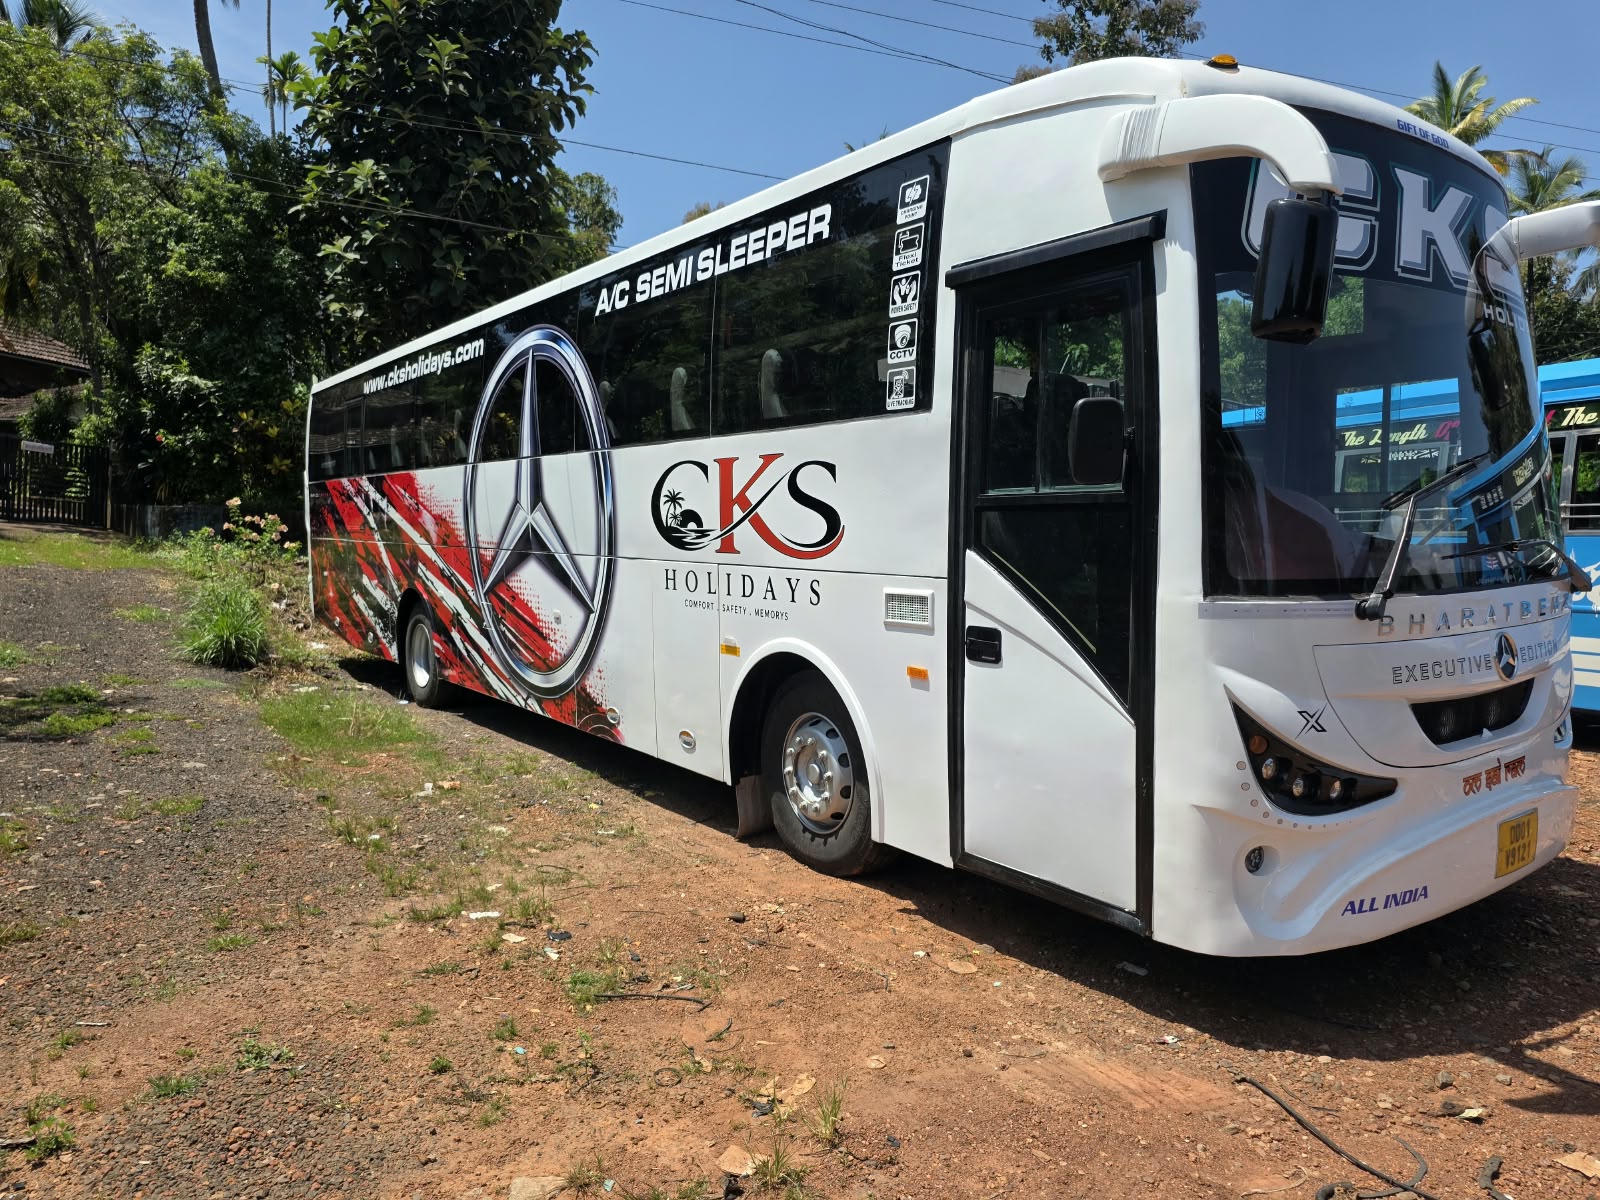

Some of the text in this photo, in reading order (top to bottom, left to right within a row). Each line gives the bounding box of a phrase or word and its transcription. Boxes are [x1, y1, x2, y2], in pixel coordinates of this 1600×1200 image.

[1397, 119, 1449, 149] GIFT OF GOD
[595, 203, 833, 317] A/C SEMI SLEEPER
[895, 257, 919, 268] Ticket
[363, 338, 484, 395] www.cksholidays.com
[889, 348, 915, 360] CCTV
[1560, 406, 1599, 427] The
[1341, 430, 1366, 447] The
[1368, 423, 1429, 446] Lngth
[651, 453, 846, 560] CKS
[664, 568, 822, 607] HOLIDAYS
[684, 599, 789, 621] COMFORT SAFETY MEMORYS
[1392, 640, 1558, 685] EXECUTIVE EDITION
[1341, 885, 1429, 917] ALL INDIA
